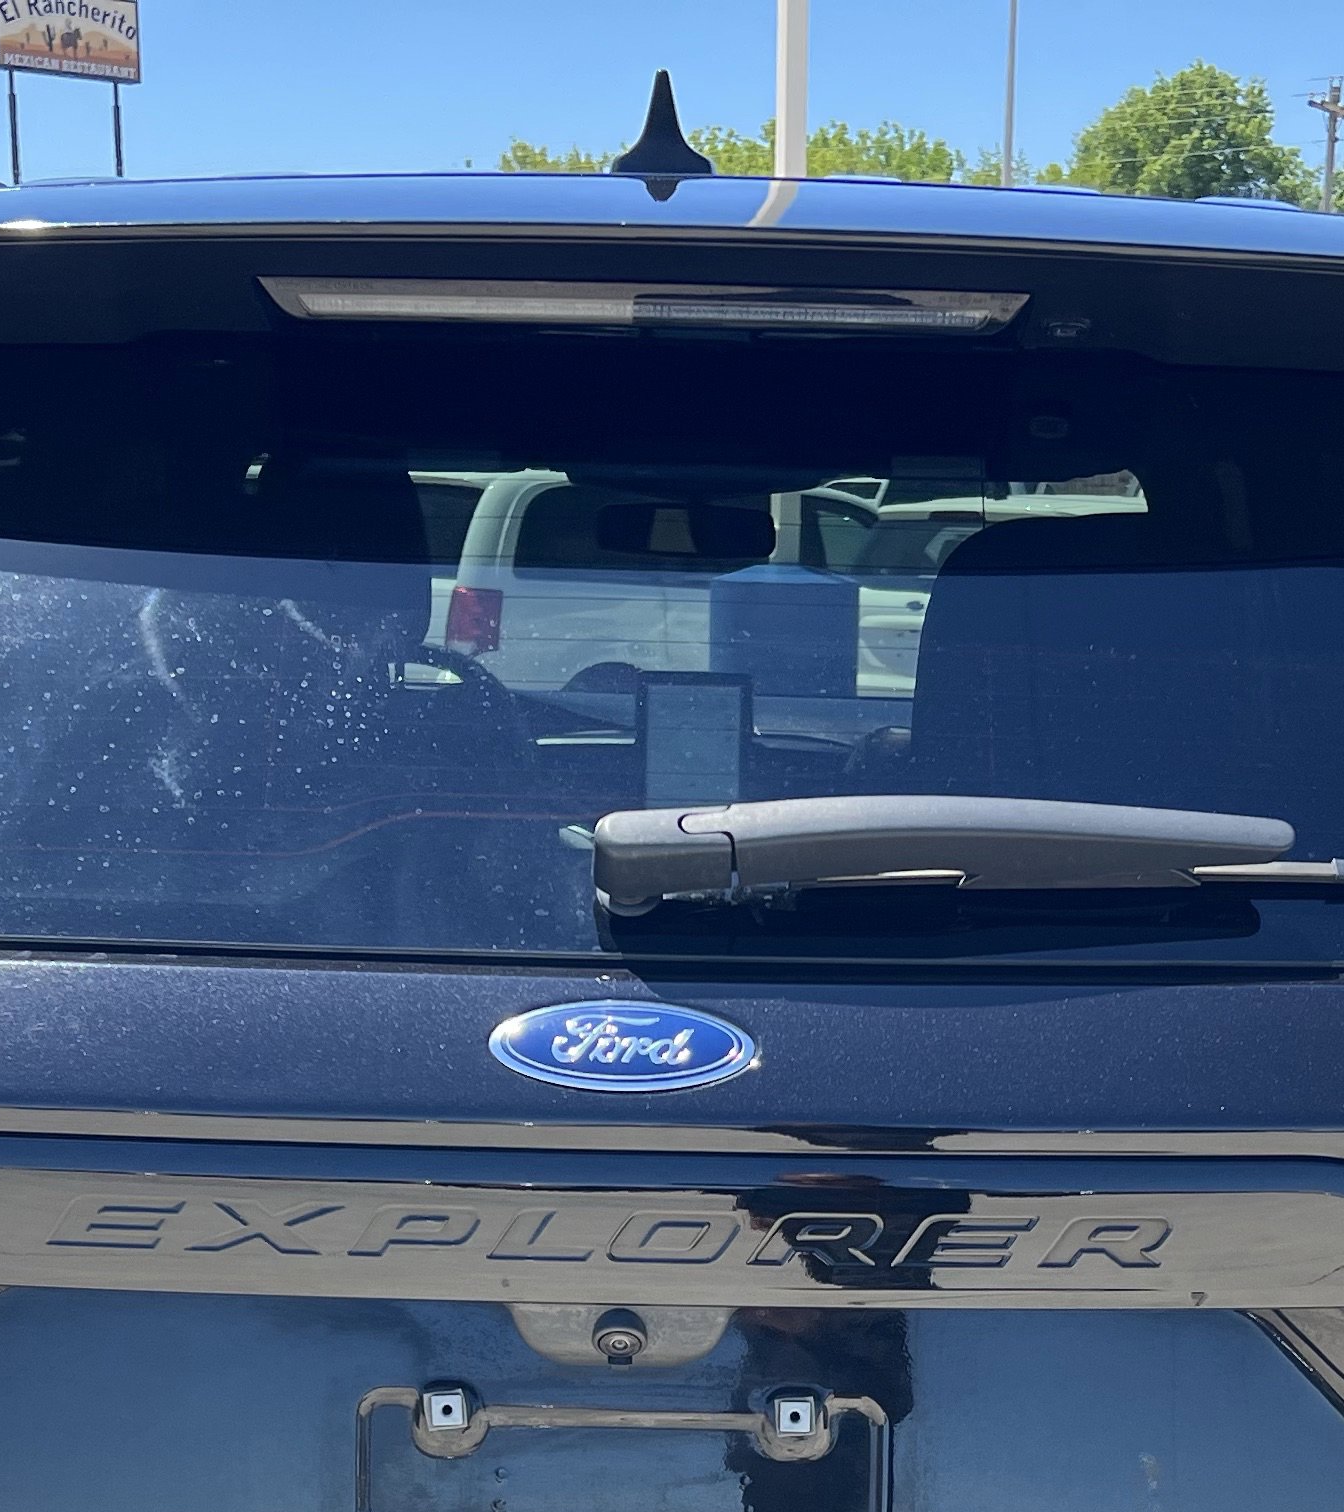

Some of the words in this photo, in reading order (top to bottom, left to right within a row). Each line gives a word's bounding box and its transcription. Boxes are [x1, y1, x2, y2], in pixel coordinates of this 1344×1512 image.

[28, 0, 136, 40] Rancherito
[4, 52, 59, 70] MEXICAN
[62, 60, 136, 79] RESTAURANT
[551, 1014, 694, 1066] Ford
[45, 1194, 1174, 1269] EXPLORER
